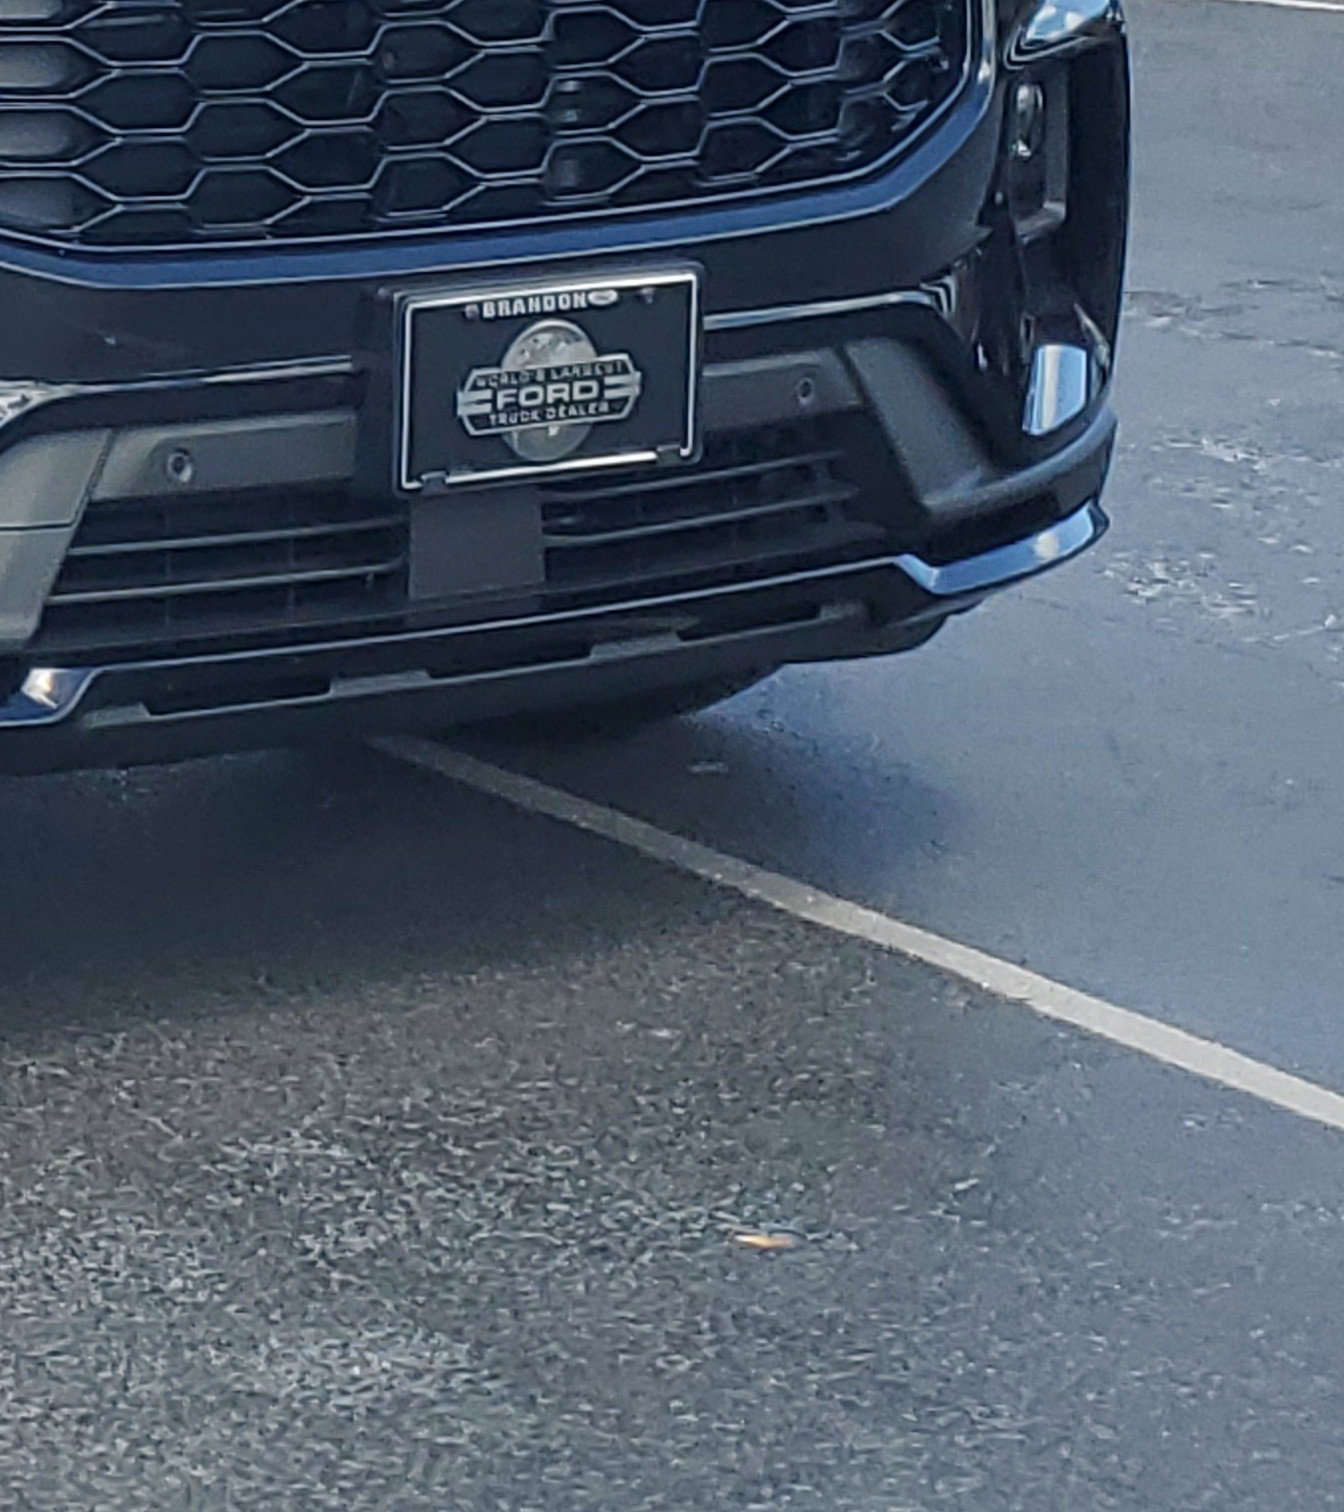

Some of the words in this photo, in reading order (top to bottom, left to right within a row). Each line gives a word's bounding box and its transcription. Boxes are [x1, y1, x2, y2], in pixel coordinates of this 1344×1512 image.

[481, 291, 588, 319] BRANDON
[496, 379, 600, 411] FORD
[488, 409, 542, 427] TRUCK
[544, 400, 610, 421] DEALER
